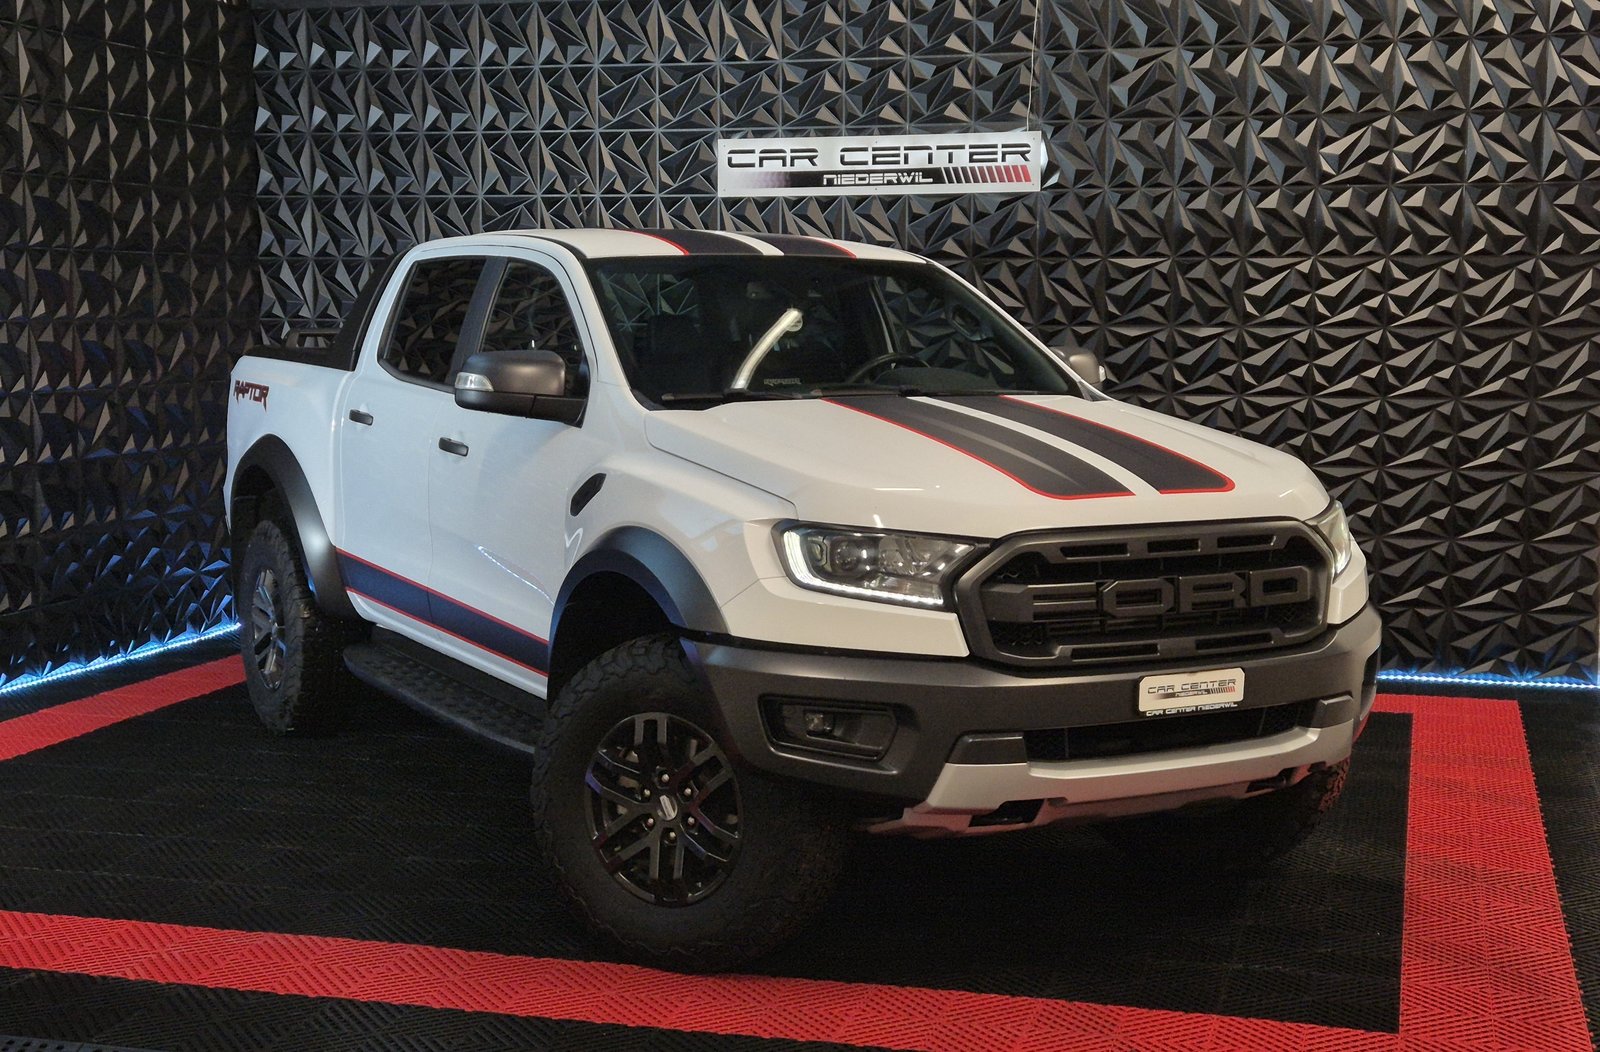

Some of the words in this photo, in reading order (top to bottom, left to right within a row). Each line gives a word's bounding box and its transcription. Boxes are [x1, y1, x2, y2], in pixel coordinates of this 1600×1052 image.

[727, 148, 819, 168] CAR
[839, 142, 1032, 166] CENTER
[233, 380, 270, 411] RAPTOR
[1014, 566, 1310, 623] FORD
[1147, 684, 1175, 694] CAR
[1181, 678, 1237, 690] CENTER
[1146, 709, 1164, 717] CAR
[1165, 706, 1197, 715] CENTER
